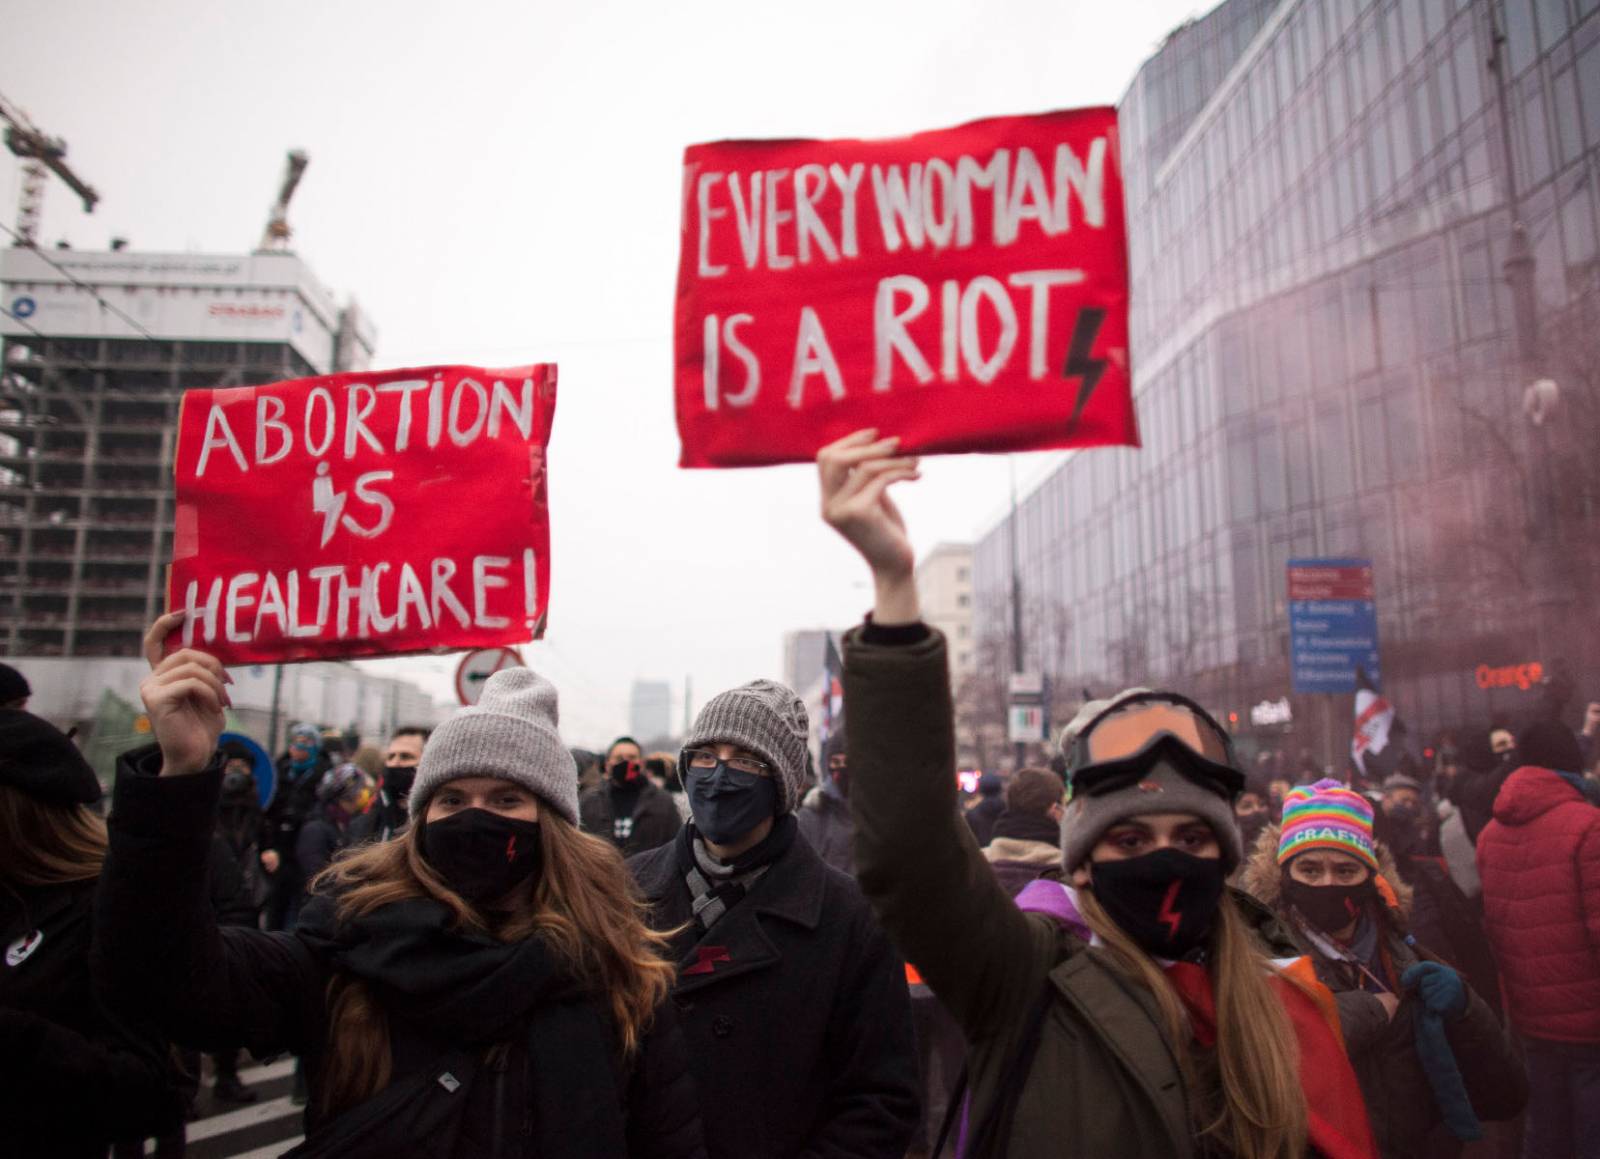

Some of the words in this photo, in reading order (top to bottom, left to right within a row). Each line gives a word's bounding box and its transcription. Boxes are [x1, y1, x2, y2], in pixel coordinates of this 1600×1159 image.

[697, 160, 865, 278] EVERY
[870, 136, 1107, 253] WOMAN
[703, 312, 761, 411] IS
[788, 306, 847, 409] A
[871, 268, 1086, 393] RIOT
[181, 548, 536, 647] HEALTHCARE!
